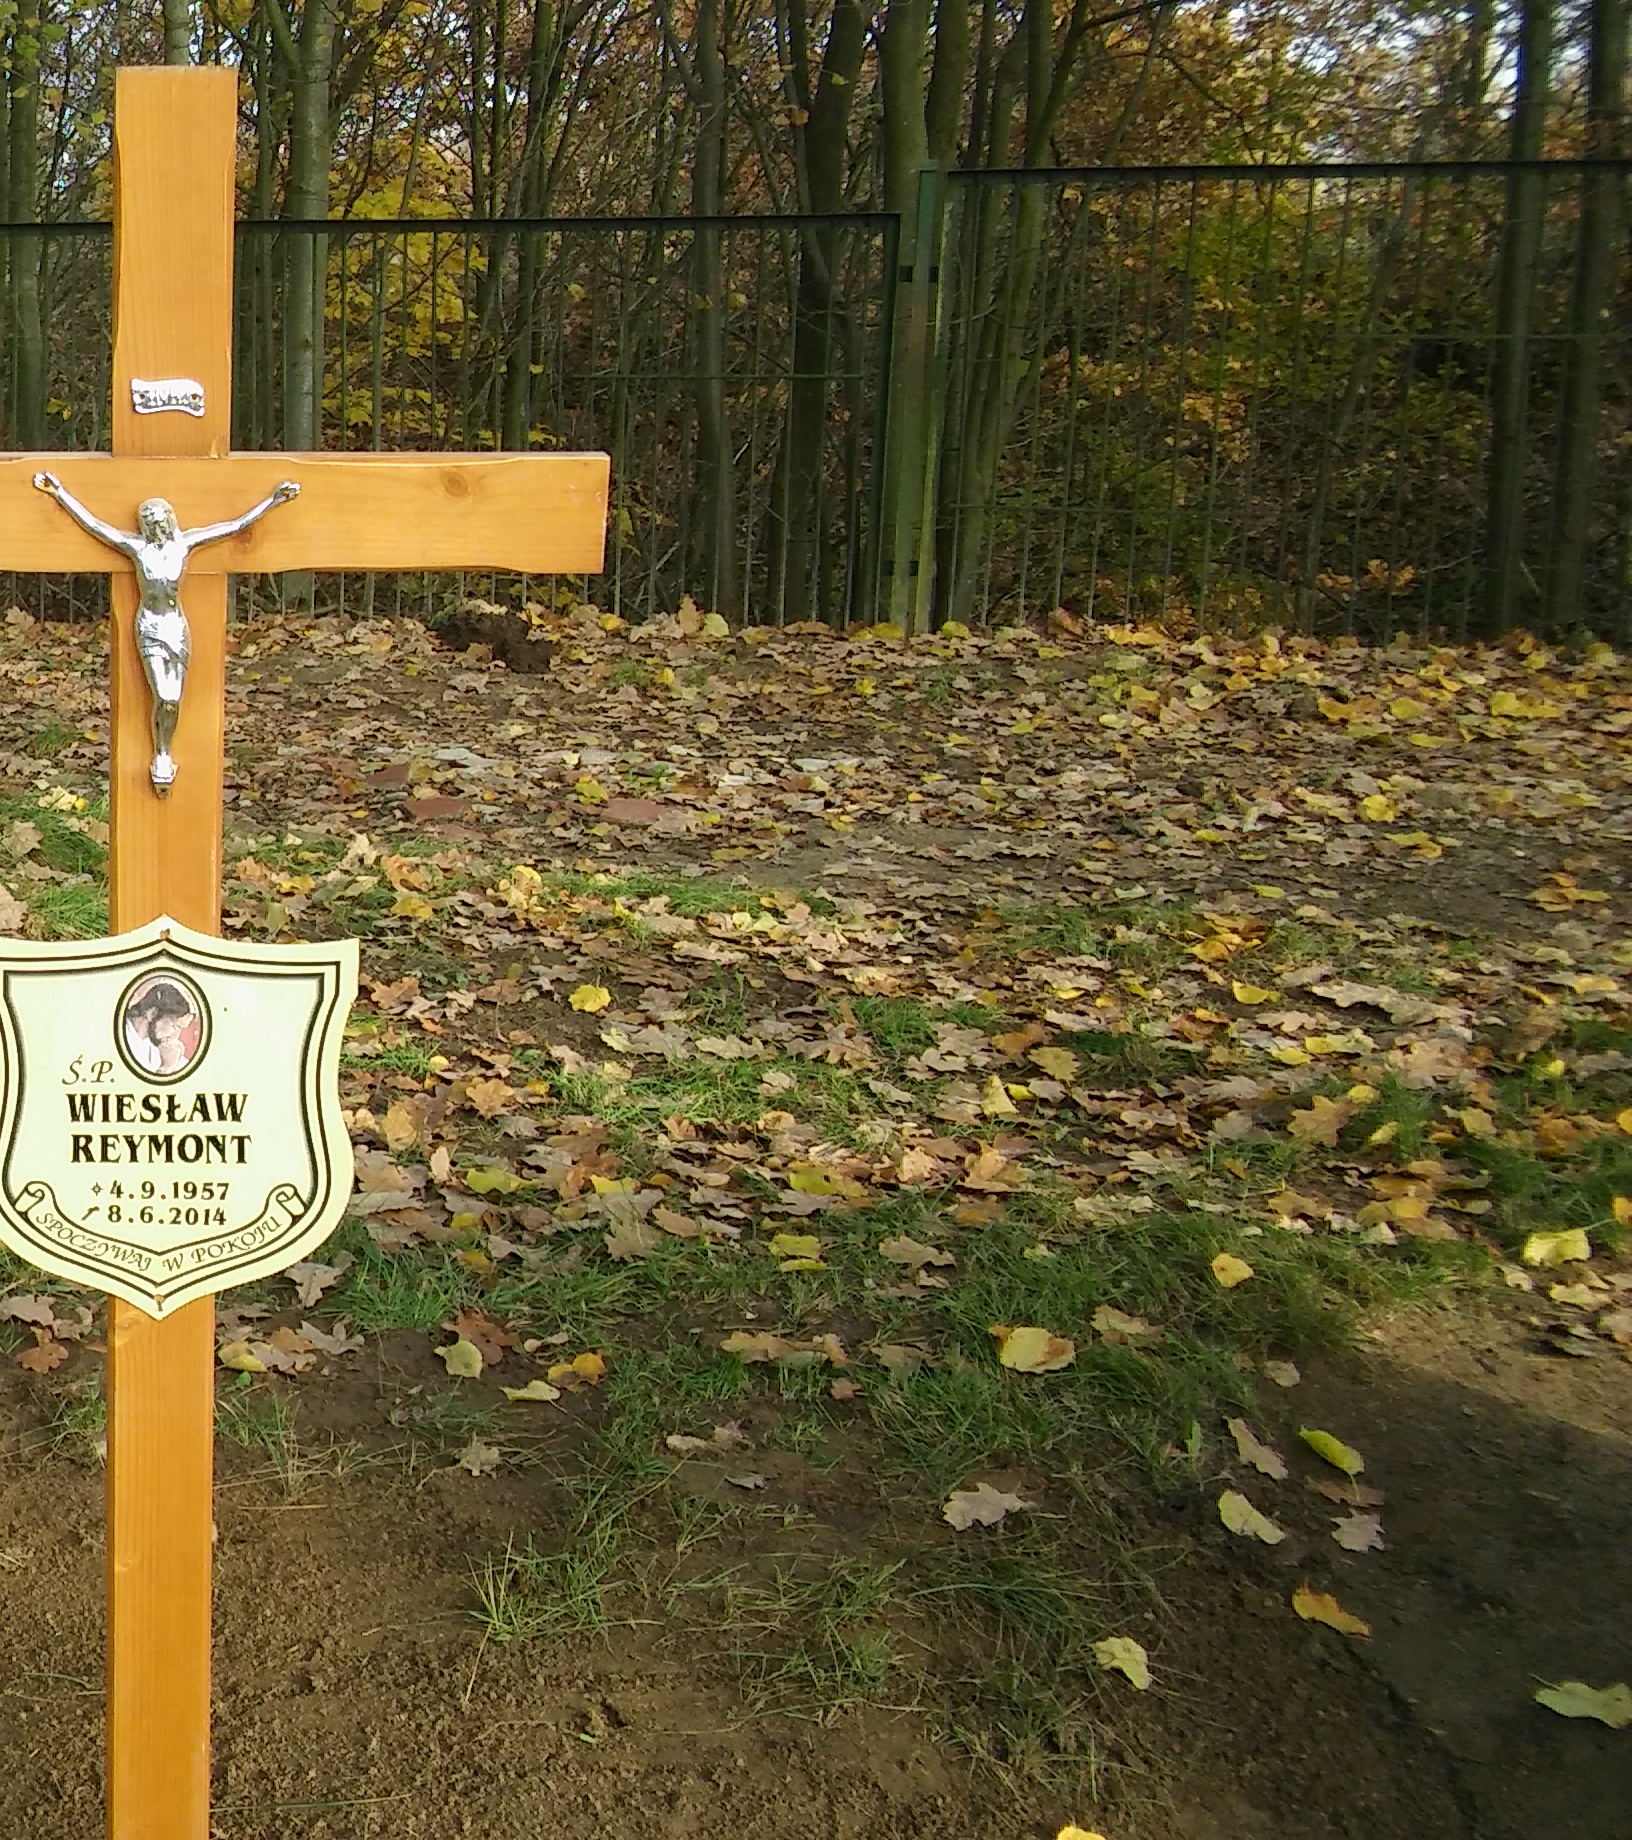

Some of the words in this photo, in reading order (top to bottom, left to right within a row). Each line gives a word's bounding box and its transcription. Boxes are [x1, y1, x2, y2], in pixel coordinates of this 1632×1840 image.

[65, 1093, 249, 1123] WIESŁAW
[71, 1134, 253, 1164] REYMONT
[109, 1181, 230, 1201] 4.9.1957
[107, 1206, 228, 1226] 8.6.2014
[36, 1212, 152, 1271] SPOCZYWAJ
[162, 1253, 185, 1273] W
[190, 1215, 283, 1264] POKOJU
